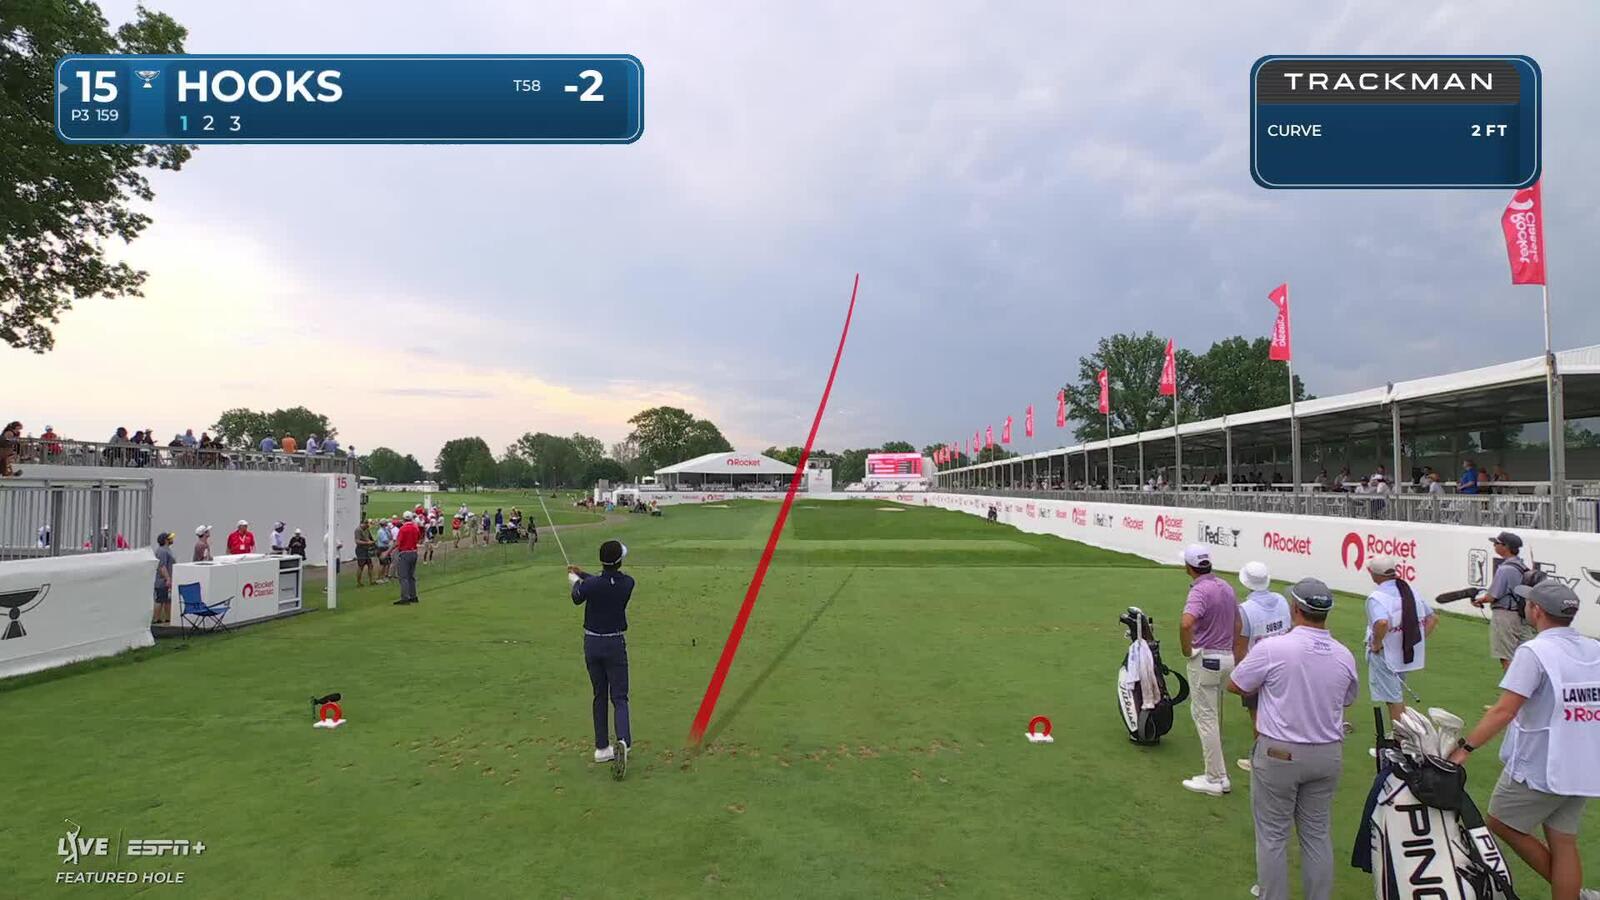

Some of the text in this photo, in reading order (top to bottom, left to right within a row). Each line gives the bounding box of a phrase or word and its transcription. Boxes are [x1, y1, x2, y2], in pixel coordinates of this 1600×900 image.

[337, 476, 348, 489] 15
[1273, 532, 1311, 555] Rocket
[1367, 534, 1416, 559] Rocket
[1562, 687, 1600, 703] LAWRE
